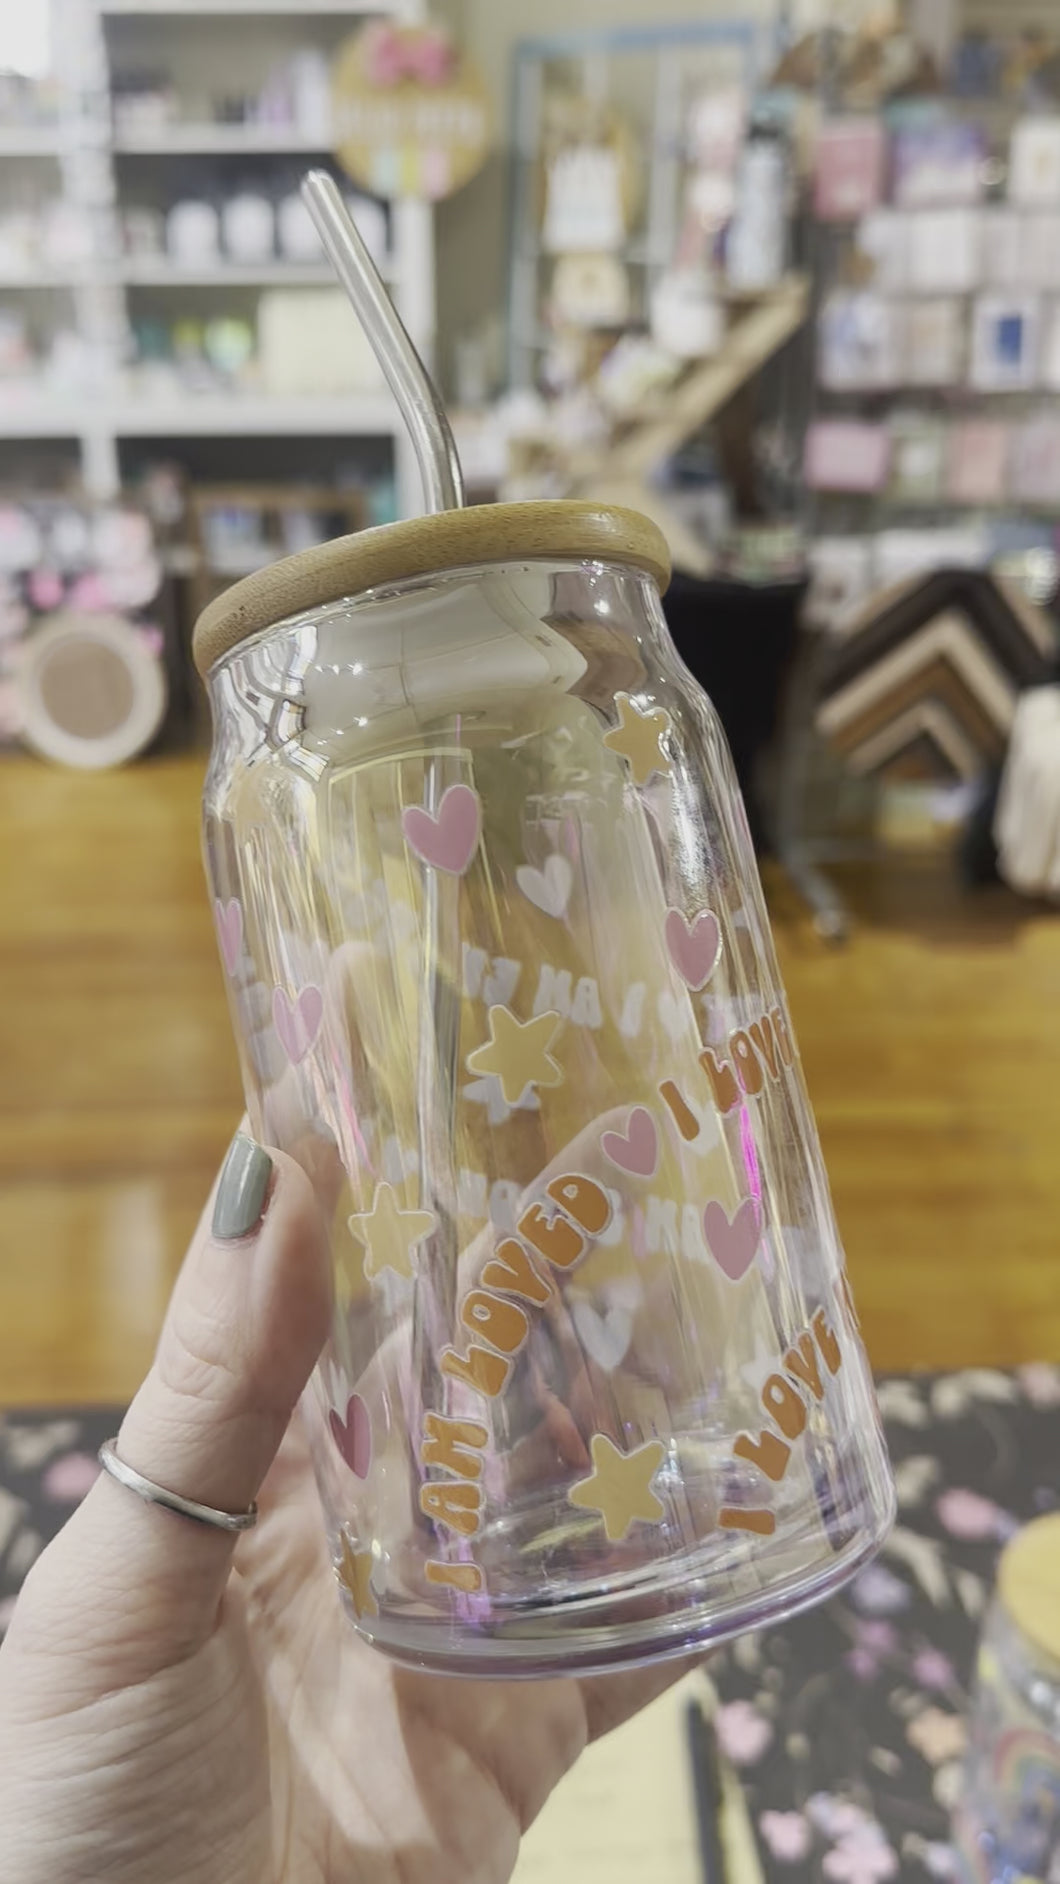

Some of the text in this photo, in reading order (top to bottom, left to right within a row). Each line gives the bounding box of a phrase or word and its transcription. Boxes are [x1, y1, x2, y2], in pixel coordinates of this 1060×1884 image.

[658, 1078, 701, 1142] I
[698, 1006, 795, 1115] LOVE
[439, 1172, 613, 1398] LOVED
[420, 1412, 489, 1536] AM
[718, 1305, 842, 1537] I LOVE
[424, 1559, 483, 1593] I
